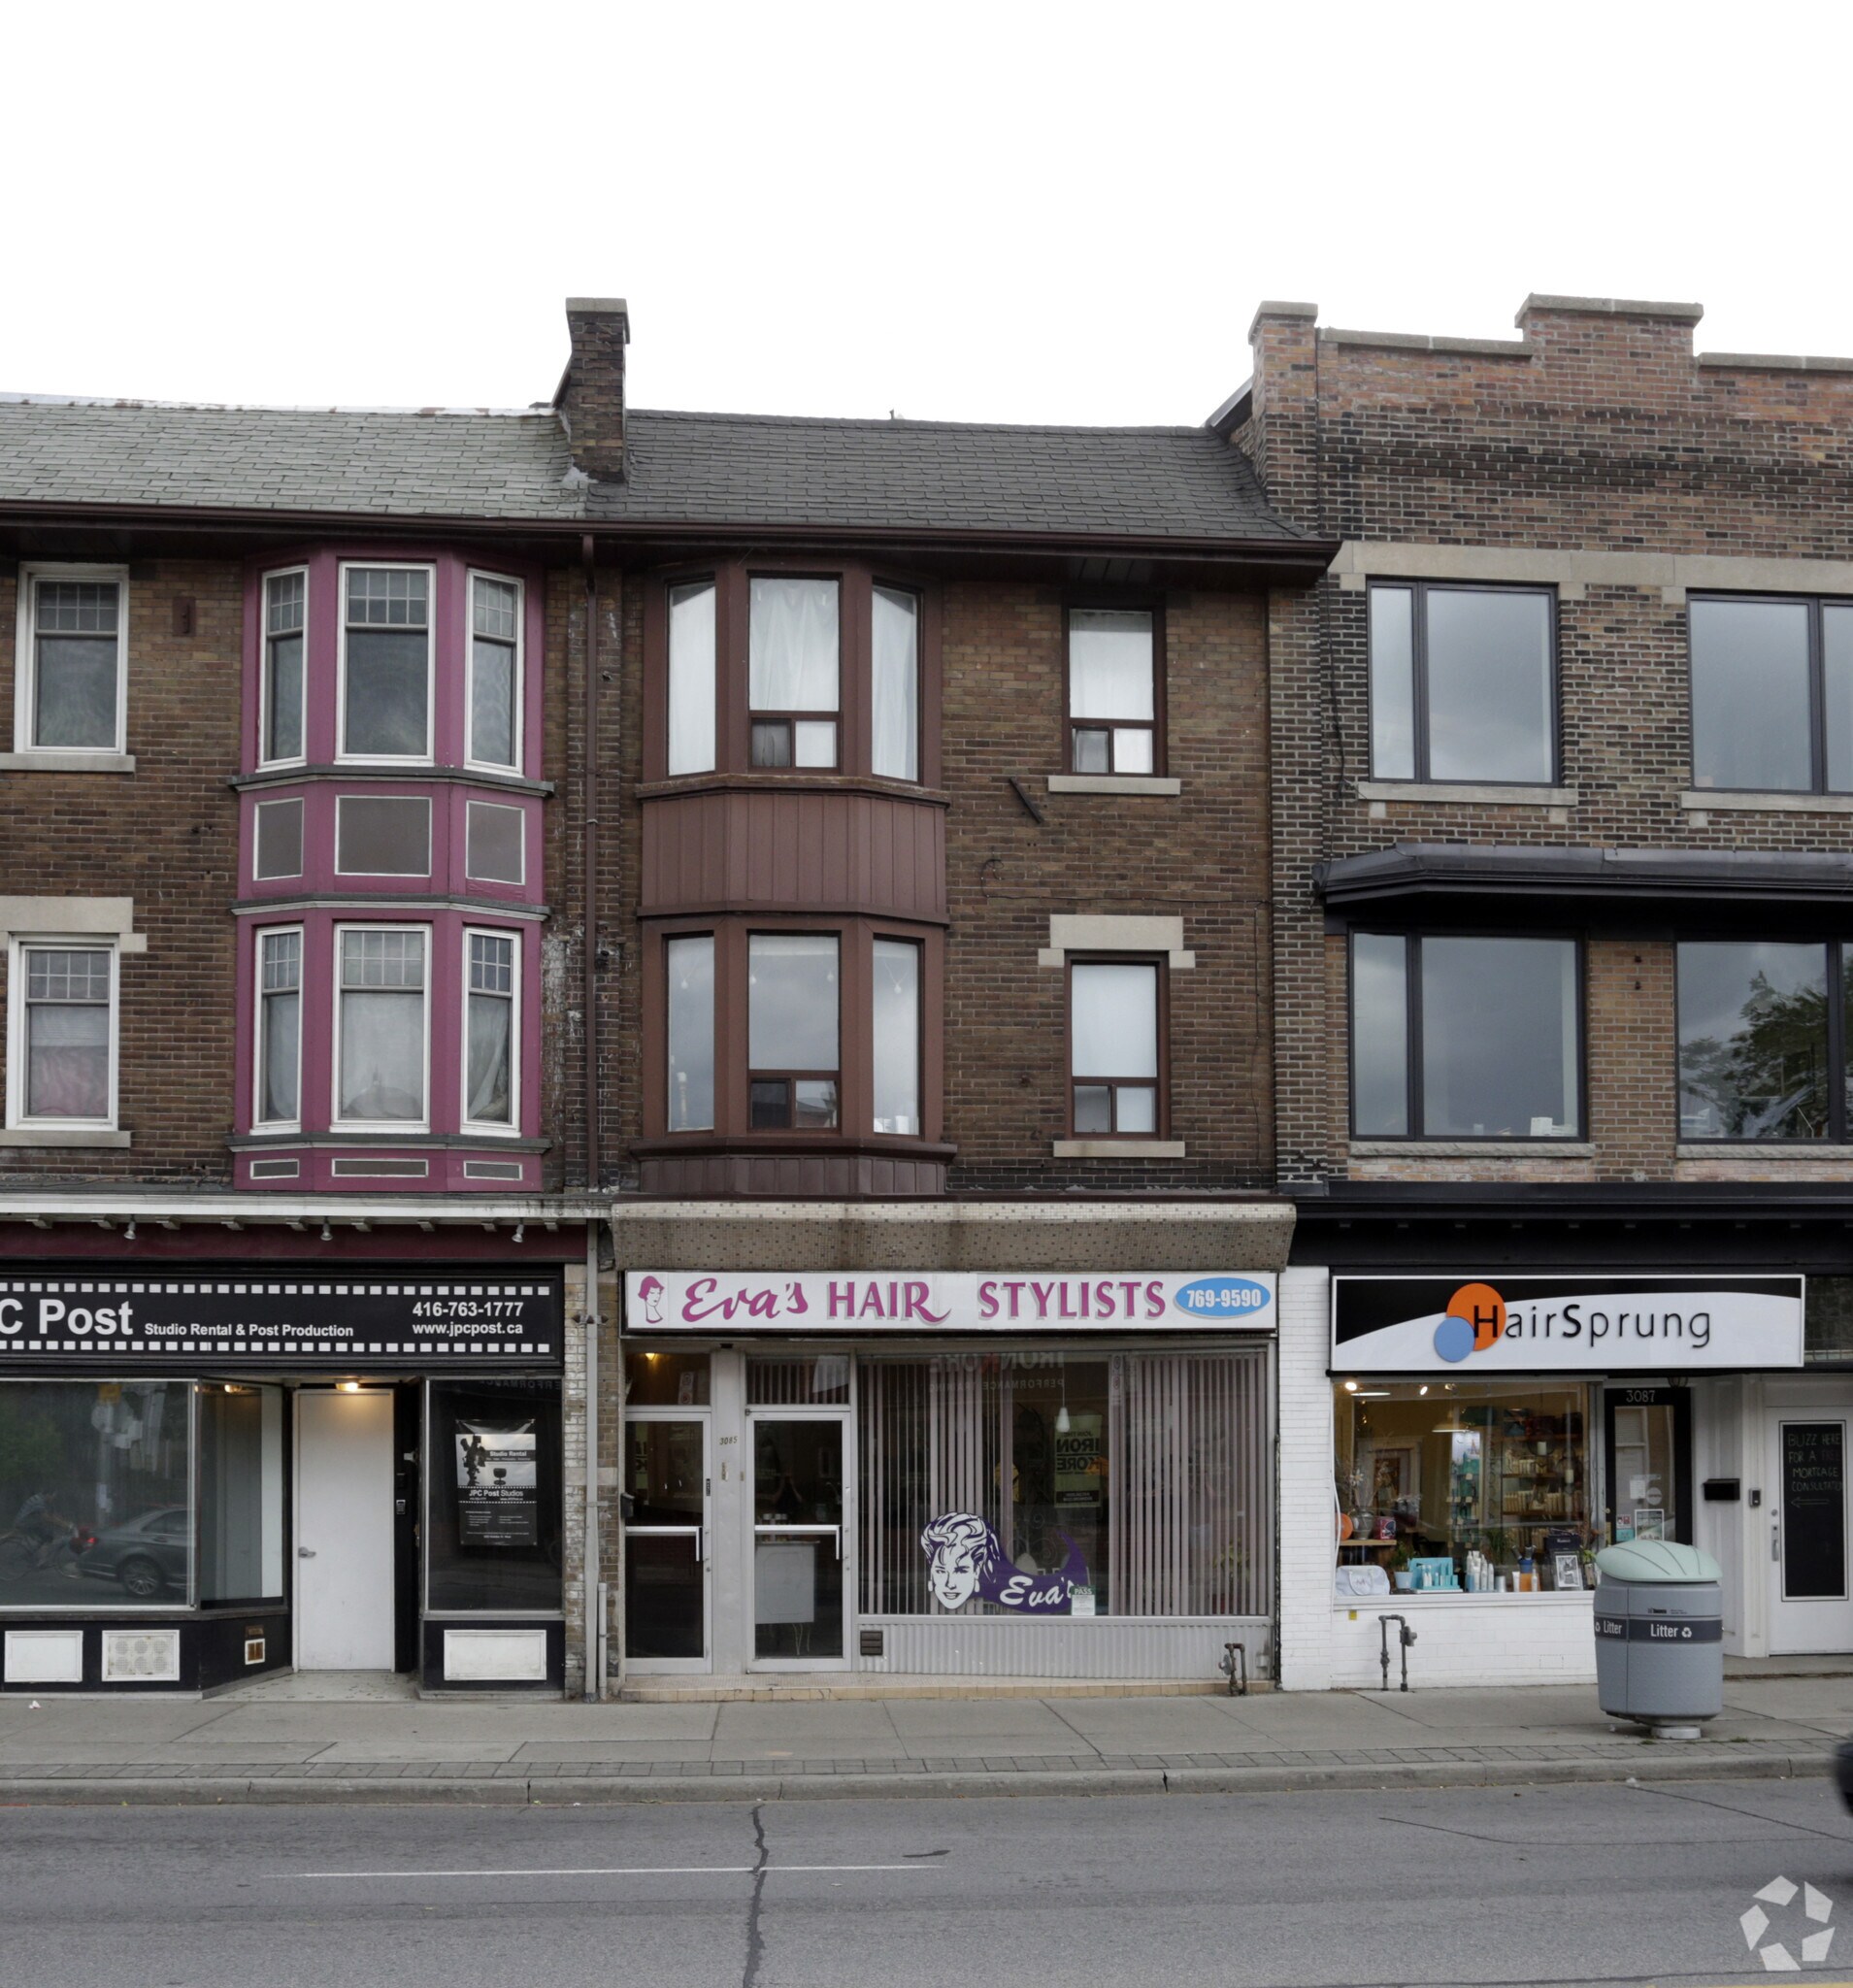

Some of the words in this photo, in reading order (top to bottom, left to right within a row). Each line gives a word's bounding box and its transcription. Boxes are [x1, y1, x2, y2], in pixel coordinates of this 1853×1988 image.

[681, 1277, 809, 1322] Eva's
[827, 1281, 951, 1326] HAIR
[978, 1280, 1167, 1320] STYLISTS
[1187, 1288, 1262, 1309] 769-9590
[413, 1302, 524, 1317] 416-763-1777
[39, 1298, 134, 1336] Post
[145, 1323, 187, 1336] Studio
[190, 1323, 232, 1336] Rental
[235, 1324, 246, 1336] &
[248, 1324, 279, 1336] Post
[282, 1325, 354, 1337] Production
[413, 1321, 524, 1337] www.jpcpost.ca
[1473, 1304, 1711, 1348] HairSprung
[1626, 1390, 1655, 1403] 3087
[719, 1436, 738, 1445] 3085
[1788, 1433, 1817, 1447] BUZZ
[1788, 1451, 1804, 1464] FOR
[1603, 1620, 1623, 1635] Litter
[1650, 1624, 1678, 1638] Litter
